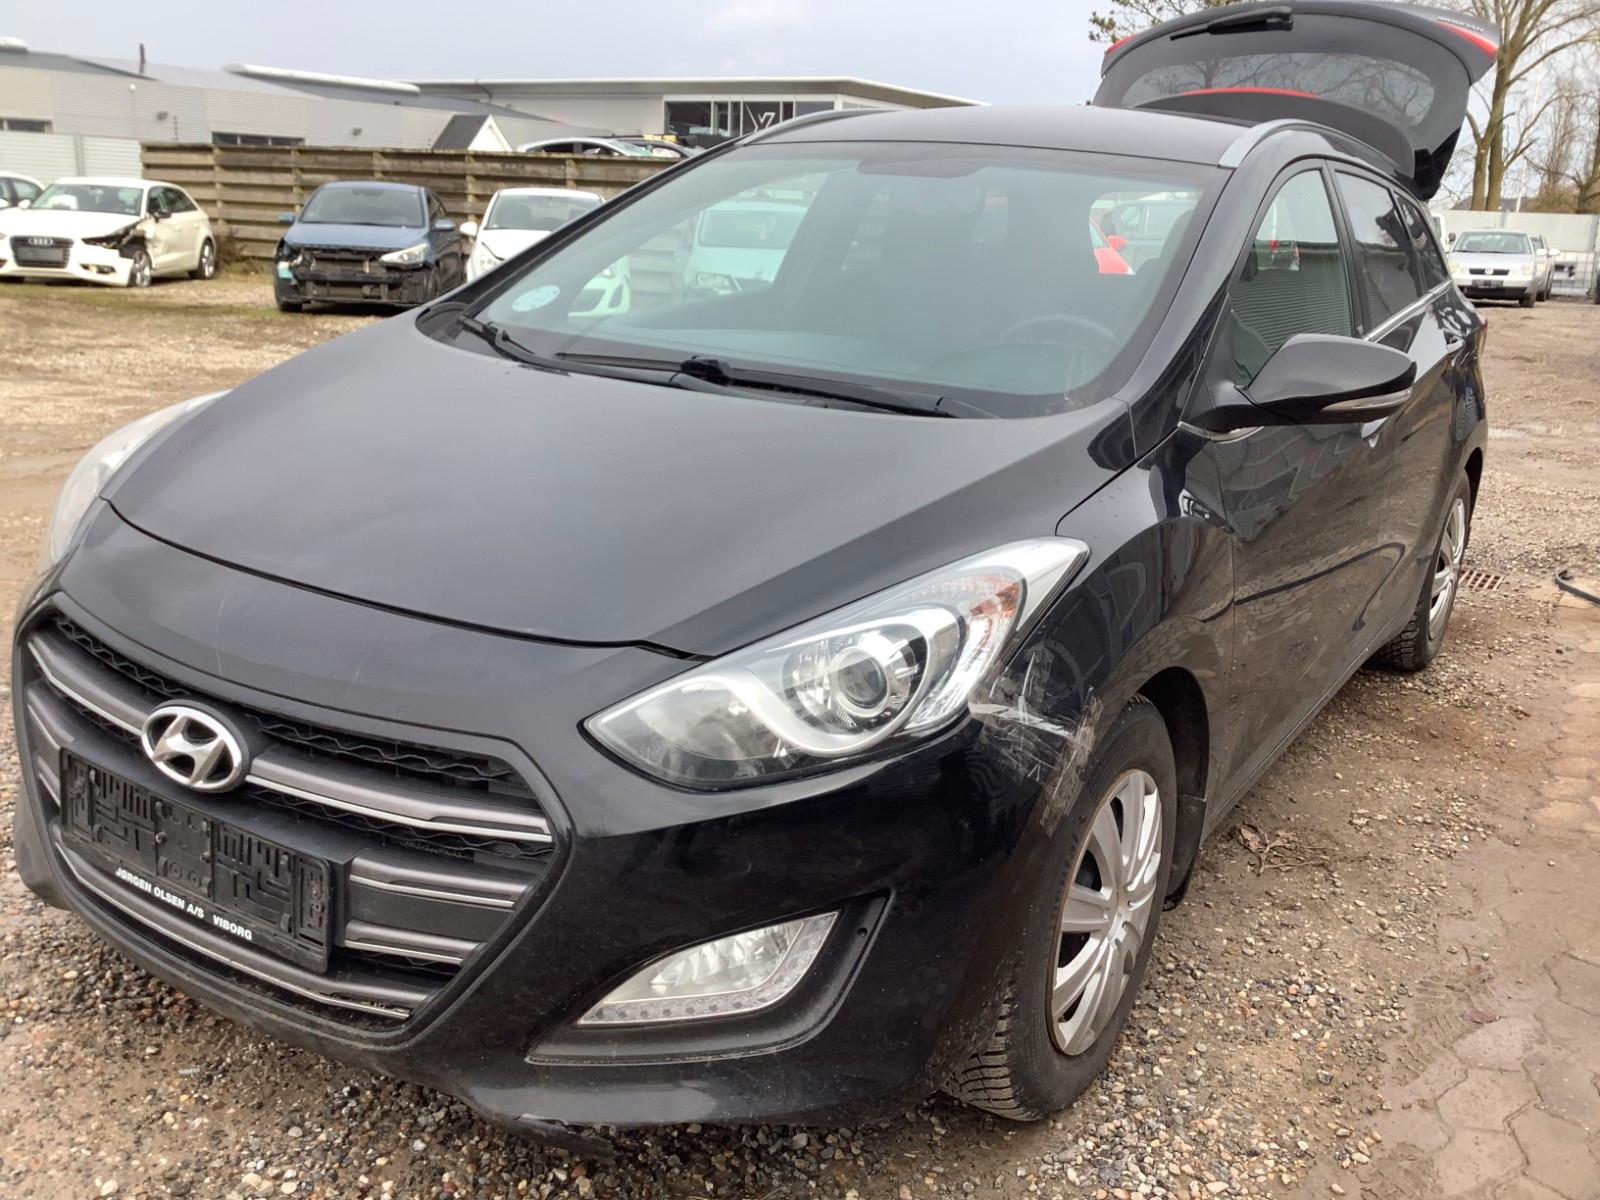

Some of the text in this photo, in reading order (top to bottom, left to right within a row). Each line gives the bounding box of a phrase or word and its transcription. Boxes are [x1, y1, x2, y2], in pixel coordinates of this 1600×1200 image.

[116, 868, 252, 940] JØRGEN OLSEN A/S VIBORG
